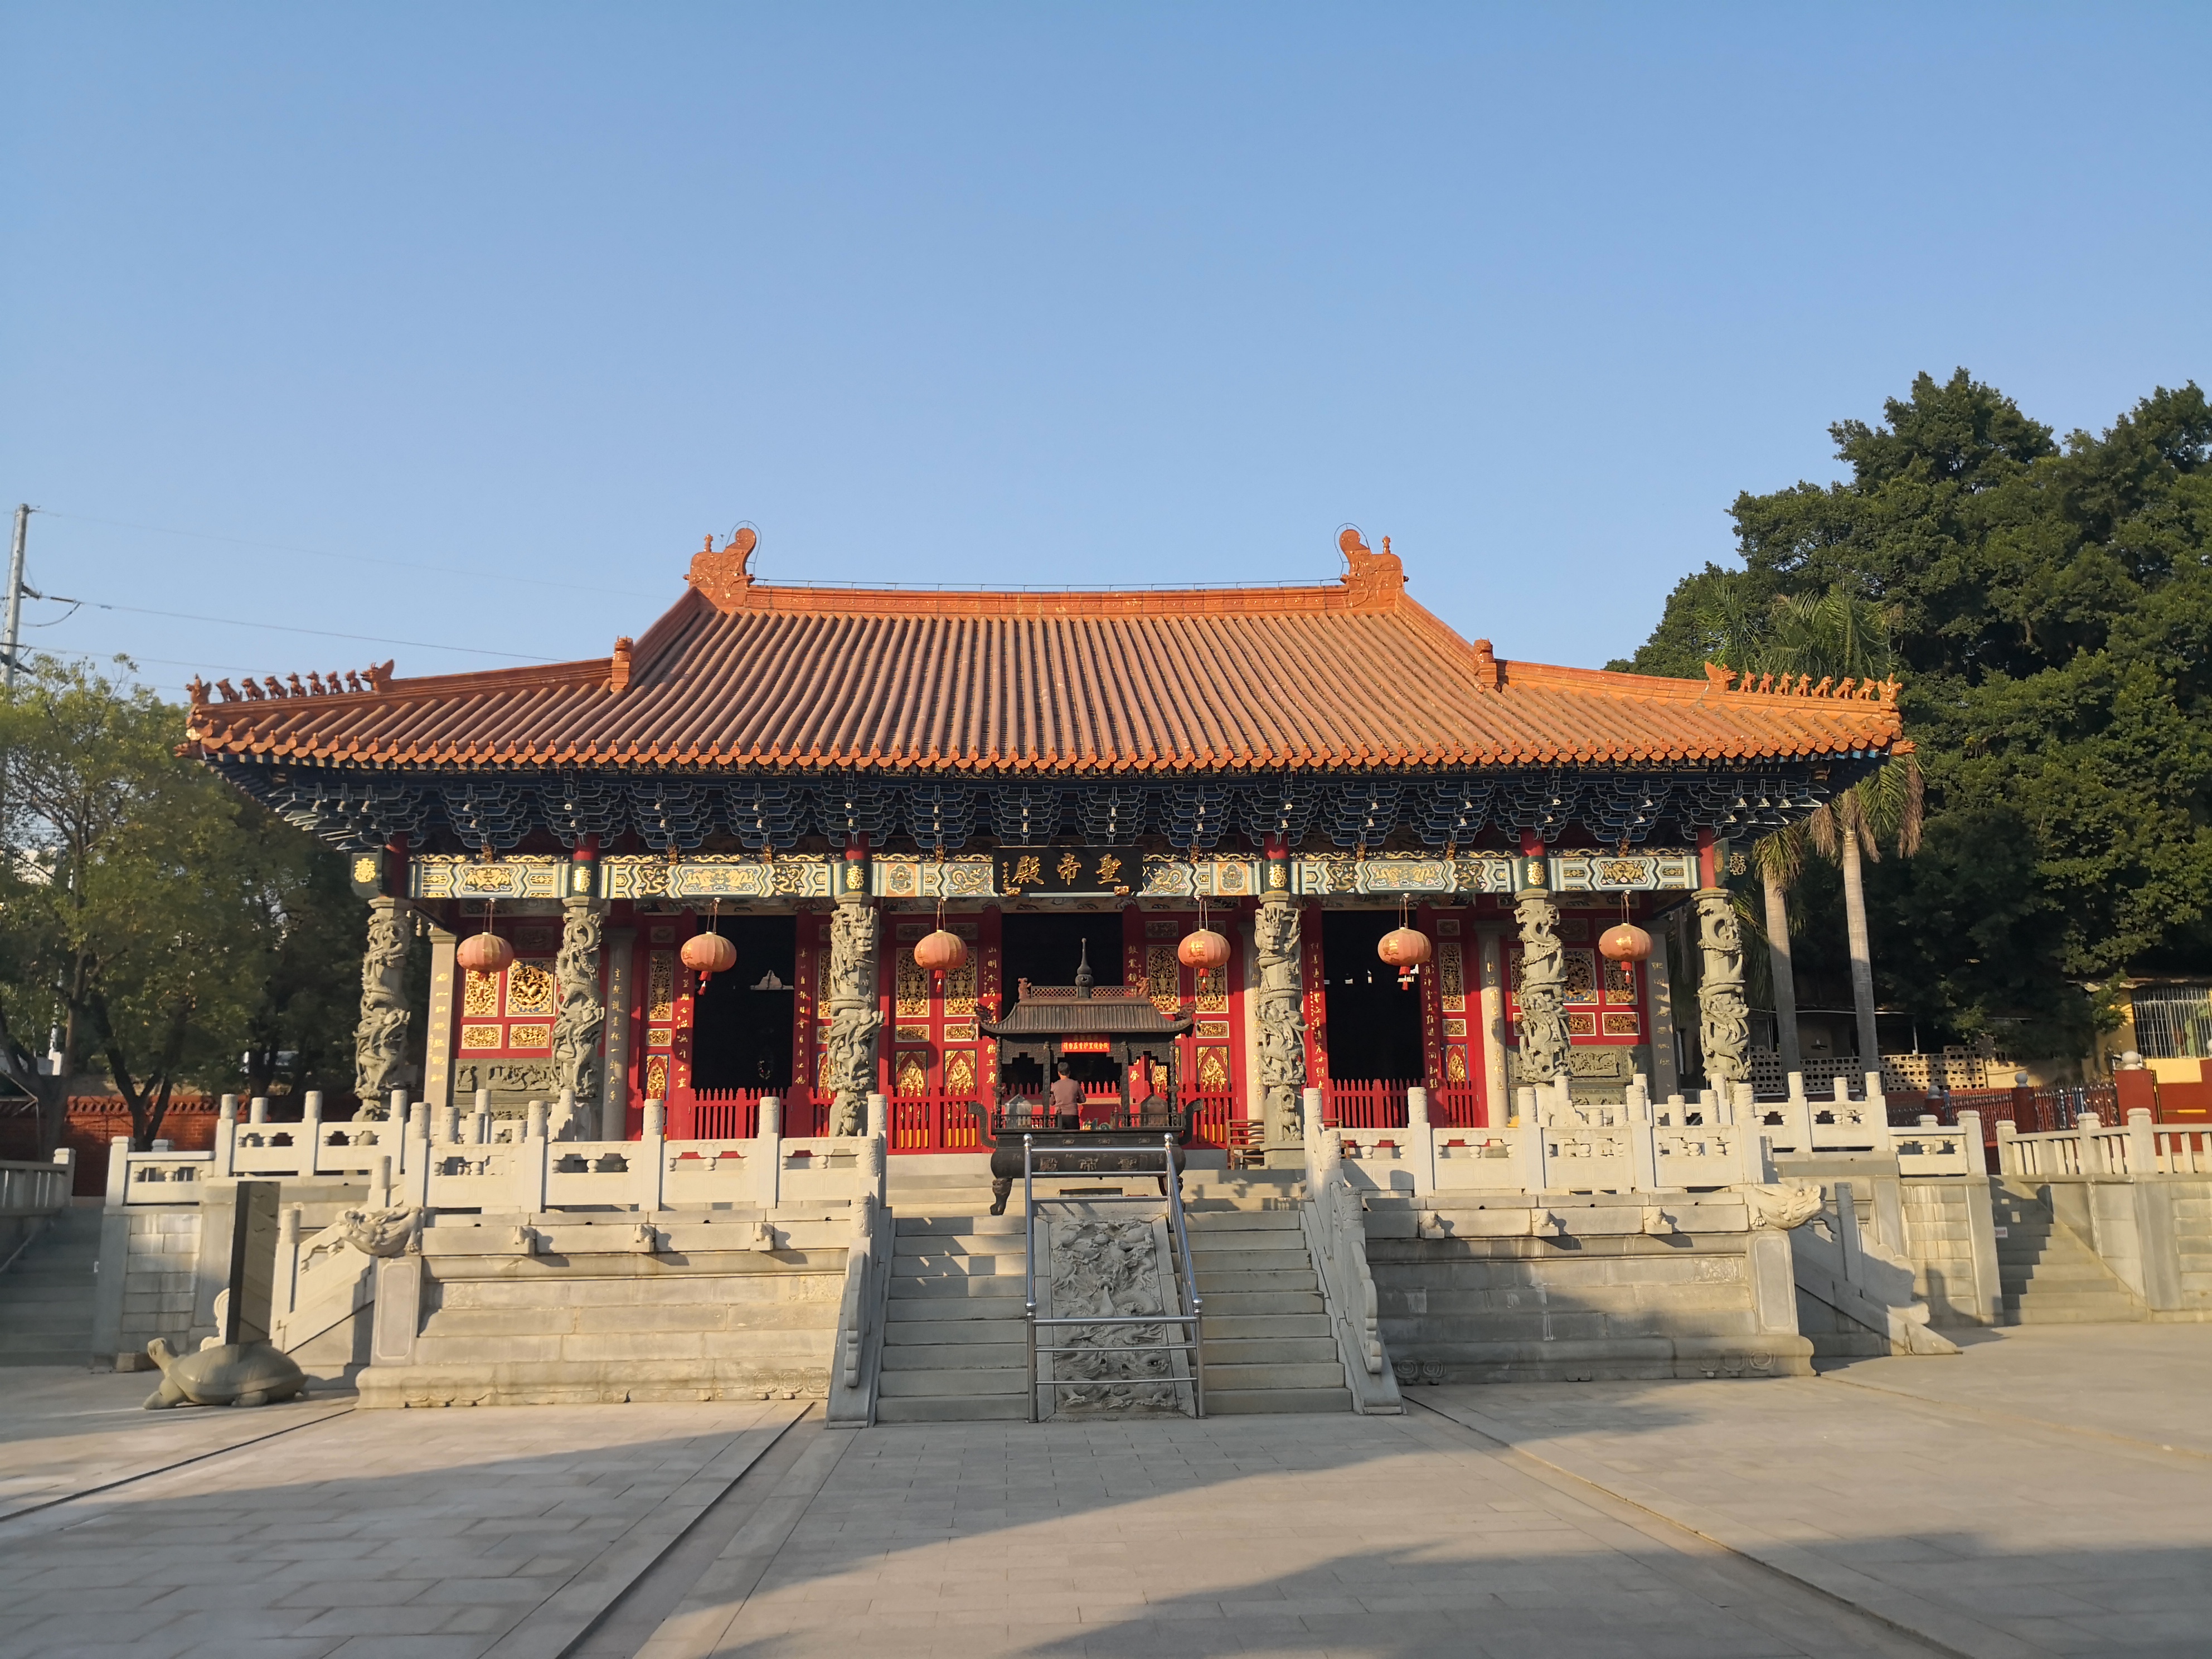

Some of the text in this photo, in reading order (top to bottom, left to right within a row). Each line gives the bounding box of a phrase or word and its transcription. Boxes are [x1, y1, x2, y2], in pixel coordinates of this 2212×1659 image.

[1011, 852, 1122, 886] 聖帝殿
[1039, 1157, 1138, 1172] 聖帝殿
